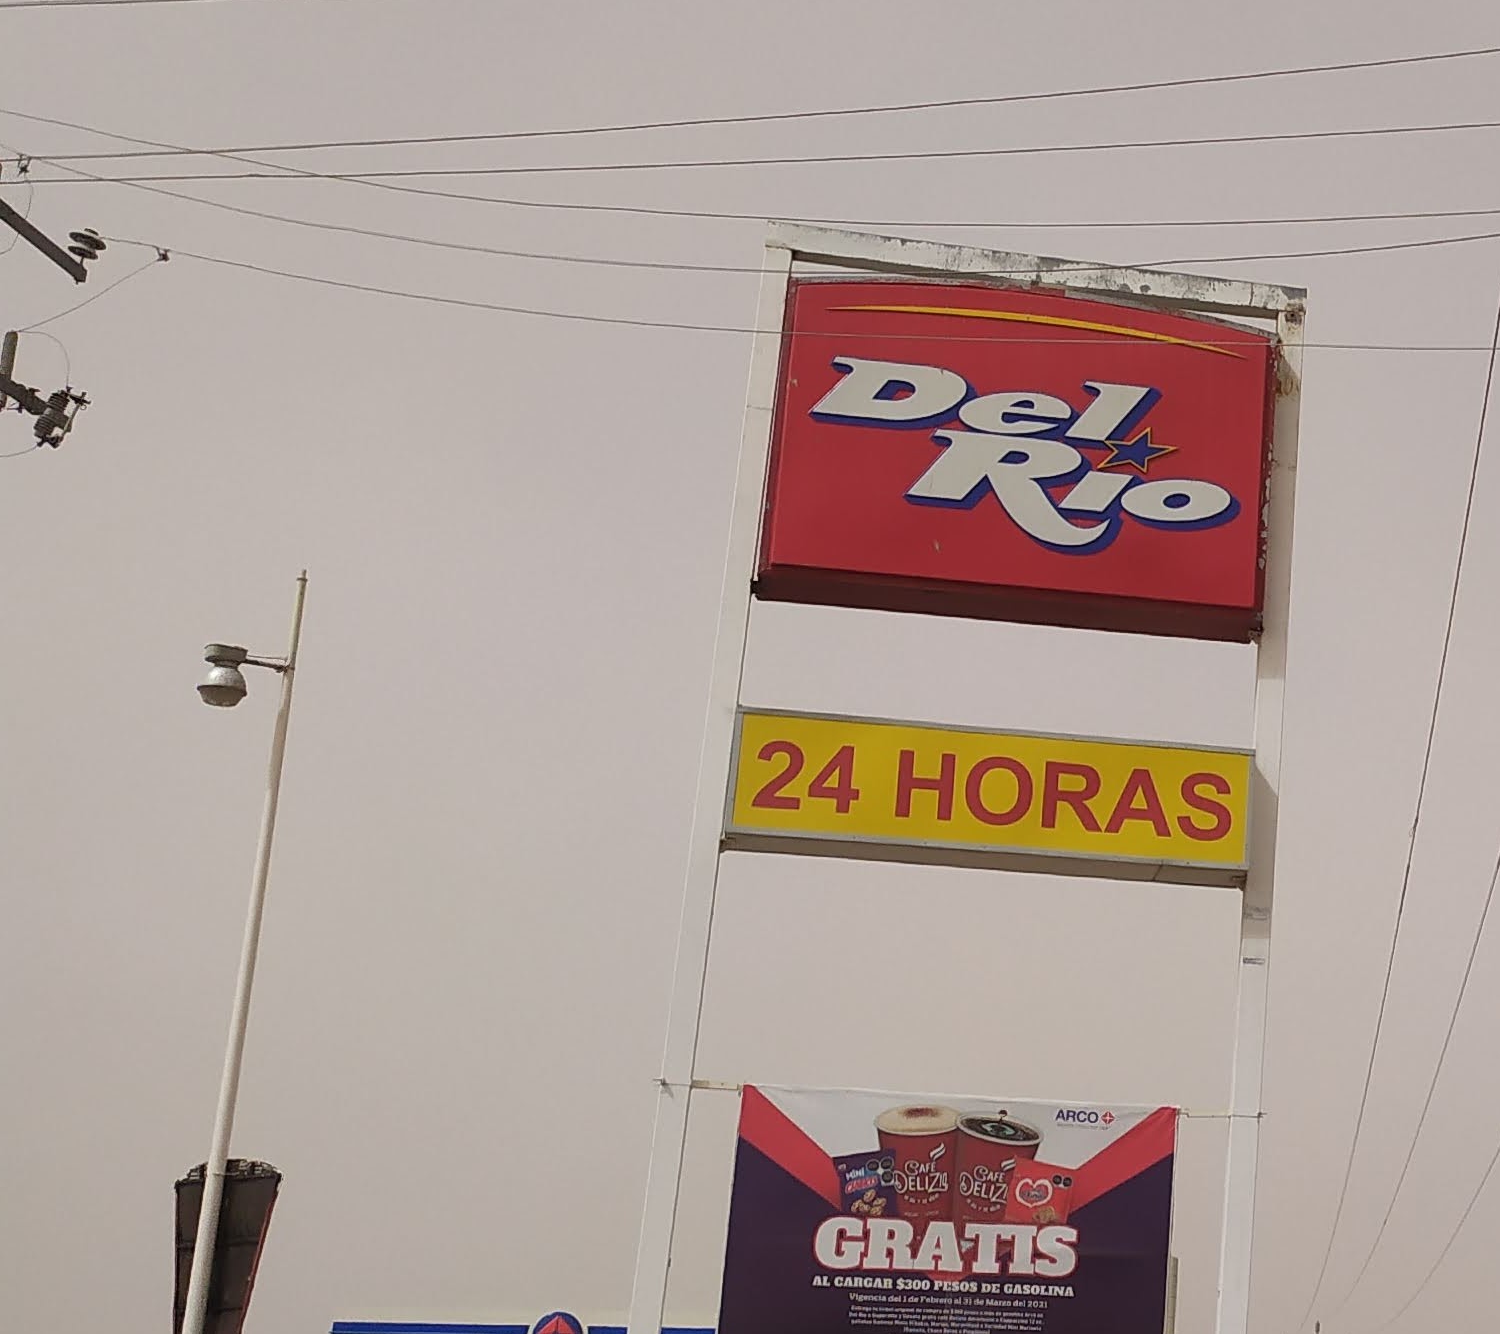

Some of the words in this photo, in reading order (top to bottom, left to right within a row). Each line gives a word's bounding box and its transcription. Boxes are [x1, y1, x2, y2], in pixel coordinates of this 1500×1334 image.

[808, 355, 1161, 450] Del
[903, 428, 1241, 555] Rio
[751, 740, 861, 814] 24
[895, 748, 1233, 842] HORAS
[1055, 1109, 1099, 1124] ARCO
[959, 1171, 1009, 1203] DELIZI
[812, 1215, 1079, 1278] GRATIS
[812, 1275, 831, 1287] AL
[833, 1275, 893, 1289] CARGAR
[896, 1277, 931, 1291] $300
[933, 1279, 978, 1293] PESOS
[981, 1282, 1001, 1294] DE
[1003, 1283, 1075, 1298] GASOLINA
[848, 1292, 887, 1304] Vigencia
[887, 1295, 902, 1304] del
[907, 1295, 920, 1304] de
[920, 1296, 953, 1305] Febrero
[985, 1297, 1012, 1308] Marzo
[1012, 1299, 1026, 1308] del
[1027, 1299, 1049, 1309] 2021
